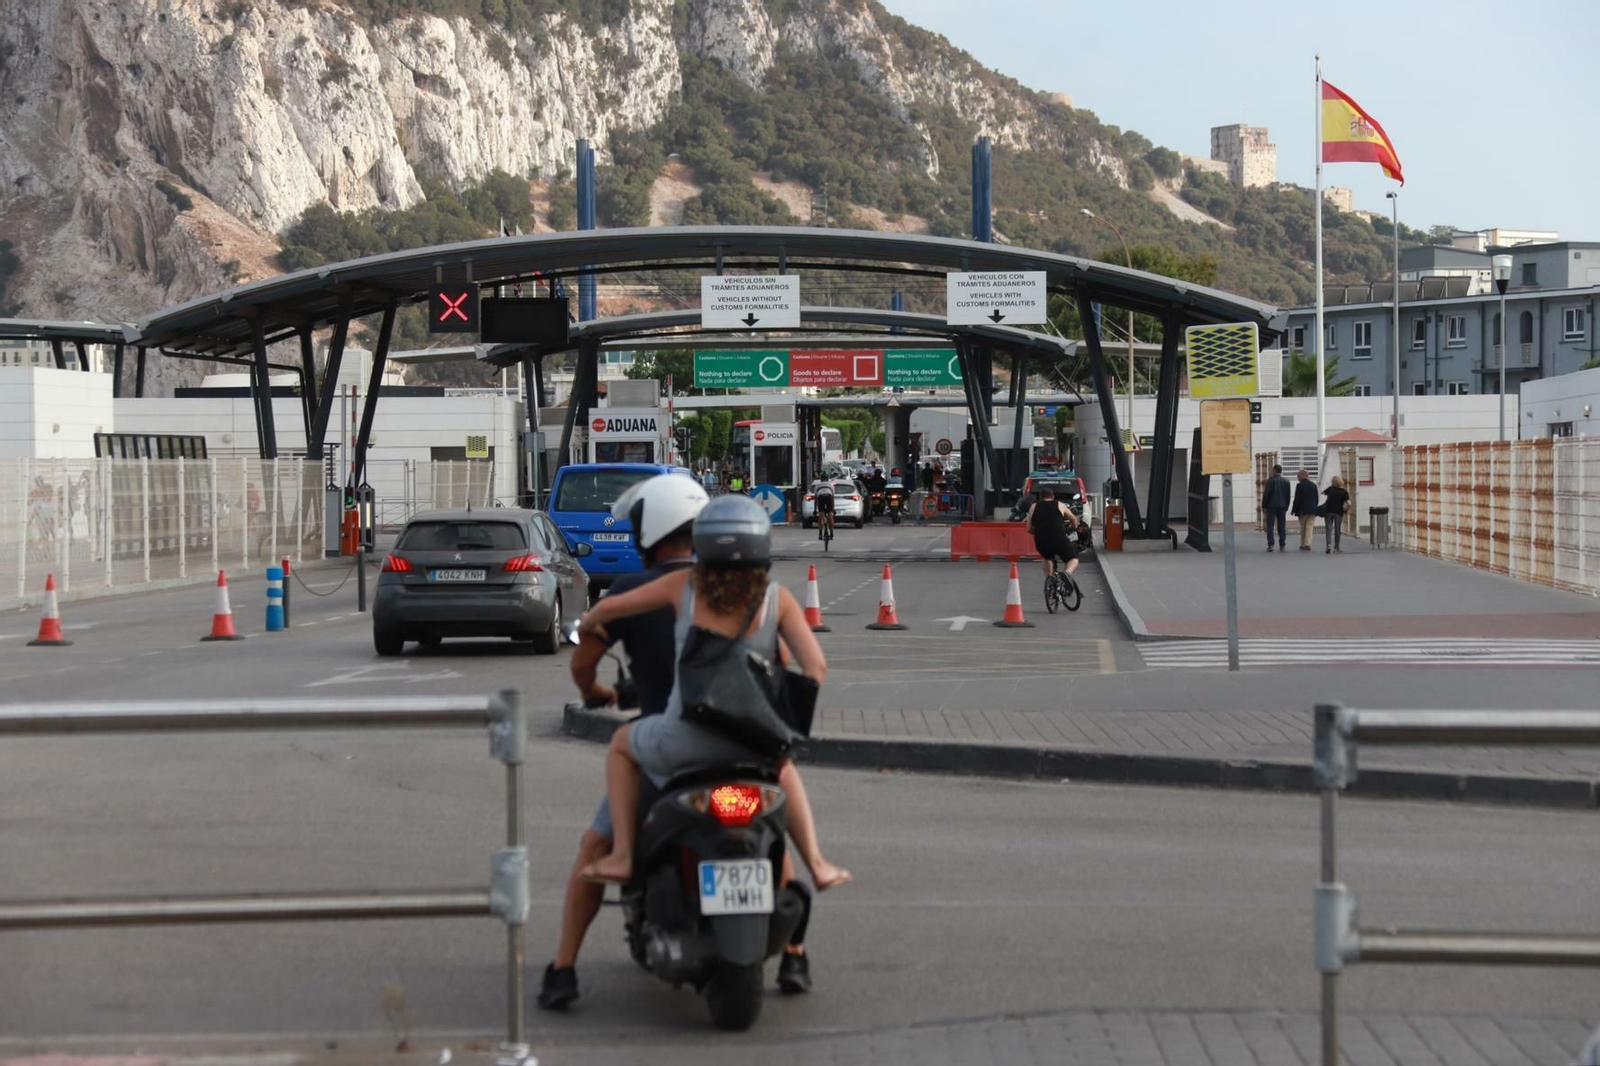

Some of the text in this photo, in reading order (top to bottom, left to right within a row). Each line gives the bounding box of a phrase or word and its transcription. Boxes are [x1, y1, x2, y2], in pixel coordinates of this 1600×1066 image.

[606, 418, 657, 432] ADUANA
[438, 570, 483, 579] 4042 KNH
[714, 864, 768, 886] 7870
